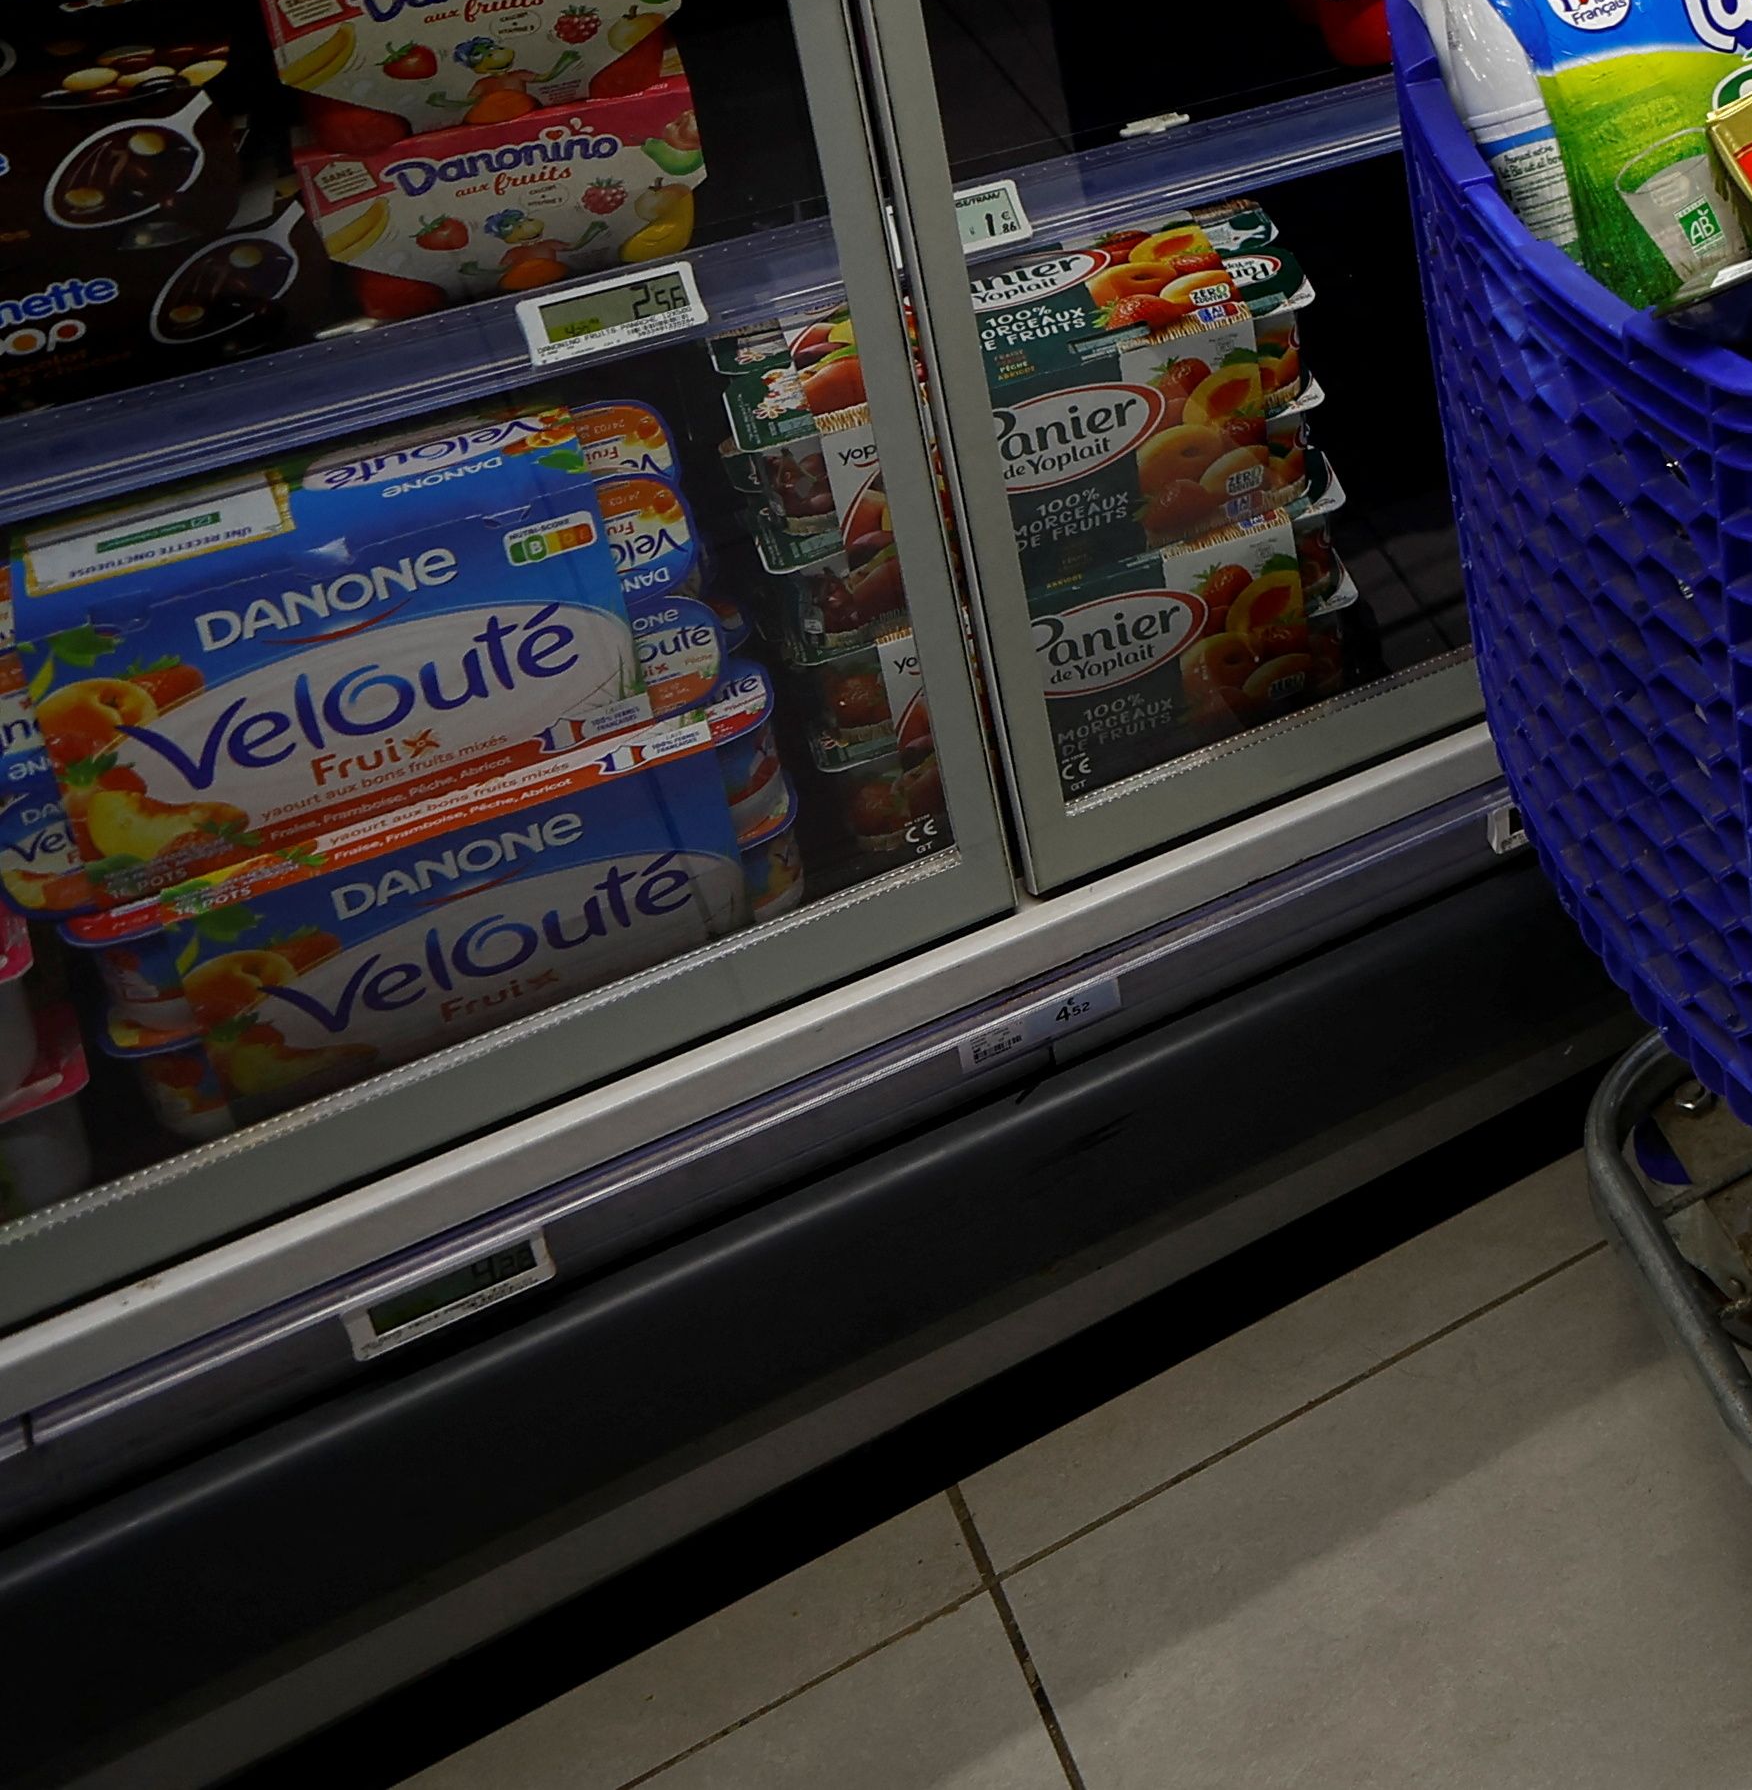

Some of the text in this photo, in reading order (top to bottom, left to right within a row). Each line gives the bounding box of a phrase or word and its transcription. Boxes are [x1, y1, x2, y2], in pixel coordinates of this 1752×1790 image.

[424, 6, 461, 26] aux
[379, 129, 622, 198] Danonino
[455, 165, 572, 200] aux fruits
[973, 276, 1058, 304] Yoplait
[985, 305, 1053, 329] 100%
[324, 419, 546, 488] Velouté
[996, 399, 1139, 464] Panier
[381, 456, 504, 499] DANONE
[1002, 437, 1113, 483] de Yoplait
[507, 516, 570, 541] NUTRI-SCORE
[1013, 489, 1130, 540] MORCEAUX
[1035, 488, 1100, 519] 100%
[194, 545, 462, 655] DANONE
[1035, 600, 1183, 664] Panier
[1050, 639, 1158, 685] de Yoplait
[114, 603, 581, 791] Velouté
[1056, 698, 1174, 746] MORCEAUX
[1082, 691, 1146, 722] 100%
[261, 735, 510, 822] yaourt aux bons fruits mixés
[310, 728, 444, 789] Fruix
[328, 761, 571, 847] yaourt aux bons fruits mixés
[333, 777, 573, 861] Fraise, Framboise, Pêche, Abricot
[329, 811, 586, 923] DANONE
[258, 851, 700, 1037] Velouté
[439, 967, 563, 1025] Fruix
[1066, 997, 1076, 1007] €
